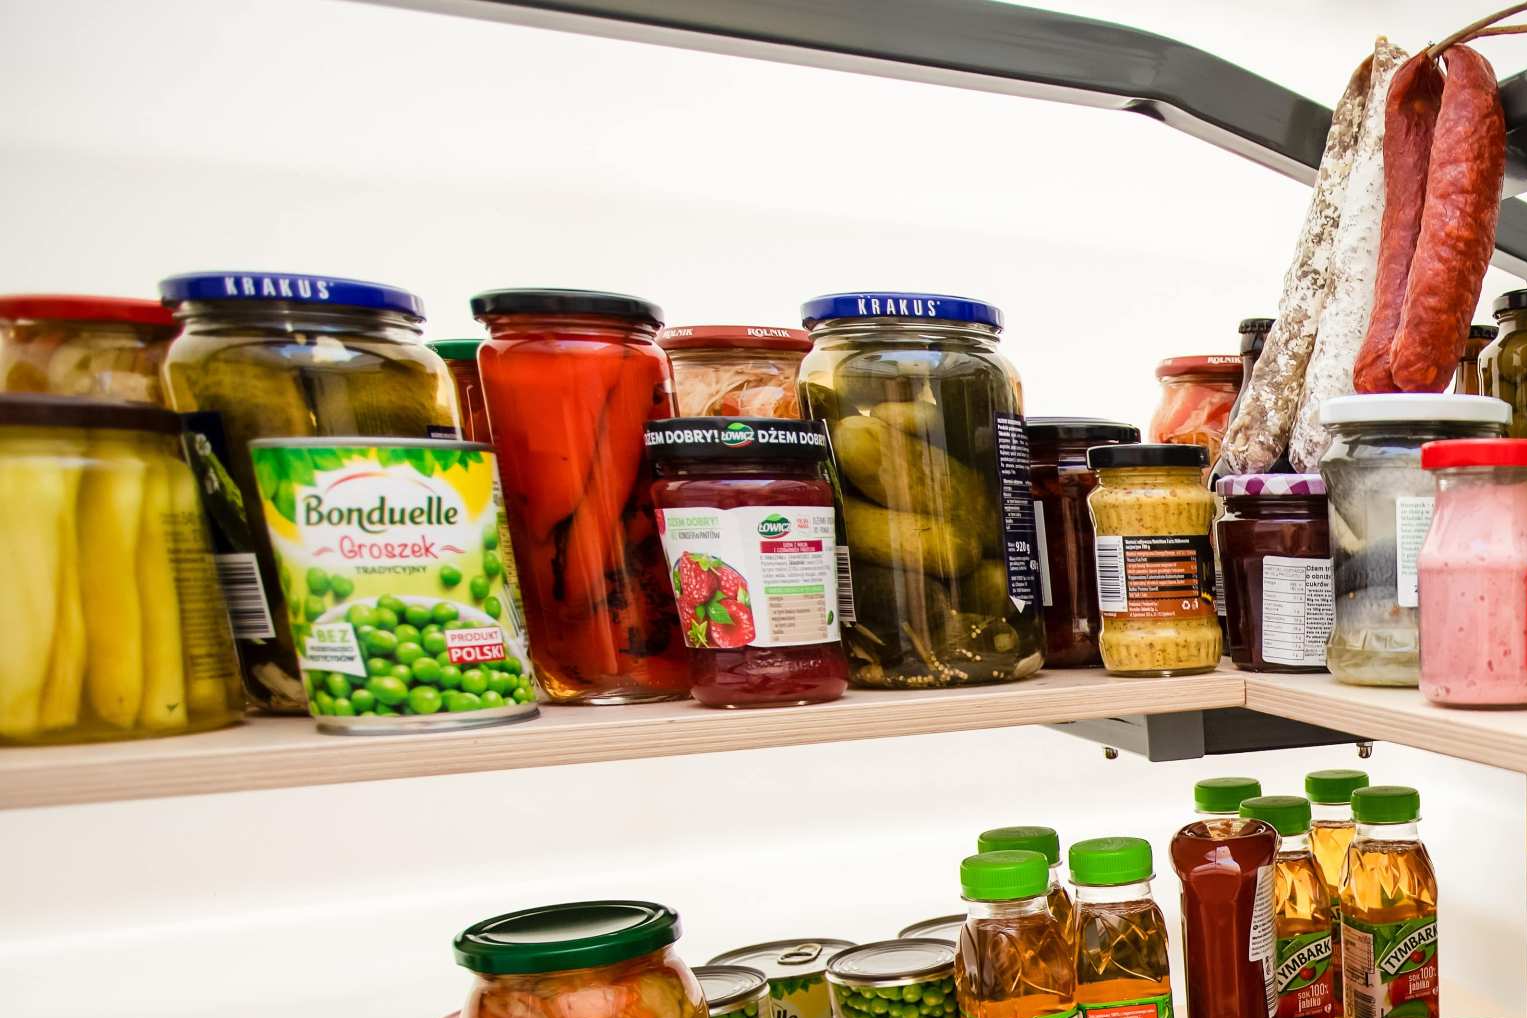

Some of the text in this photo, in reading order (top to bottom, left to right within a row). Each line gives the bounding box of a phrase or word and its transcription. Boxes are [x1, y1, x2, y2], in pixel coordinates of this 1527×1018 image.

[224, 276, 331, 300] KRAKUS
[858, 297, 937, 317] KRAKUS
[747, 327, 791, 338] ROLNIK
[666, 428, 720, 445] DOBRY!
[757, 427, 798, 445] DŻEM
[303, 494, 458, 534] Bonduelle
[339, 534, 439, 560] Groszek
[355, 565, 427, 576] TRADYCYJNY
[450, 630, 499, 643] PRODUKT
[451, 645, 505, 662] POLSKI
[1384, 923, 1438, 971] TYMBARK
